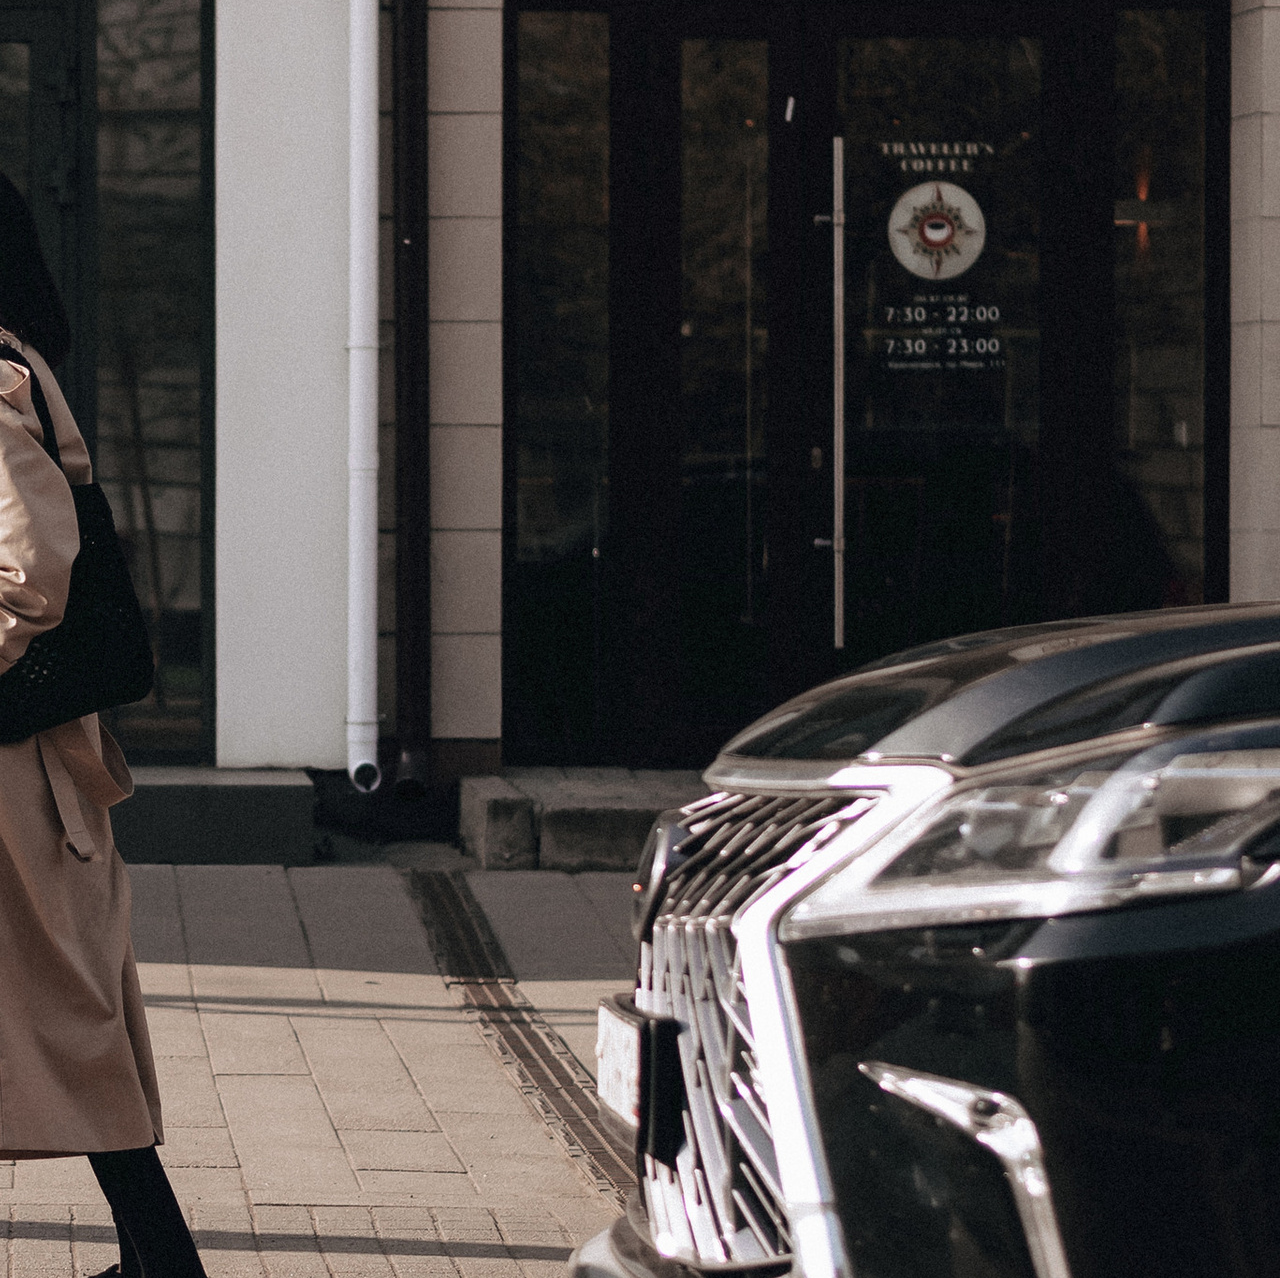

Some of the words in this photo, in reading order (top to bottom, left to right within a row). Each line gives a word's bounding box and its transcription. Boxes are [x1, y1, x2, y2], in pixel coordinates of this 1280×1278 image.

[885, 305, 927, 323] 7:30
[946, 305, 1001, 323] 22:00
[885, 337, 927, 355] 7:30
[946, 337, 1001, 355] 23:00
